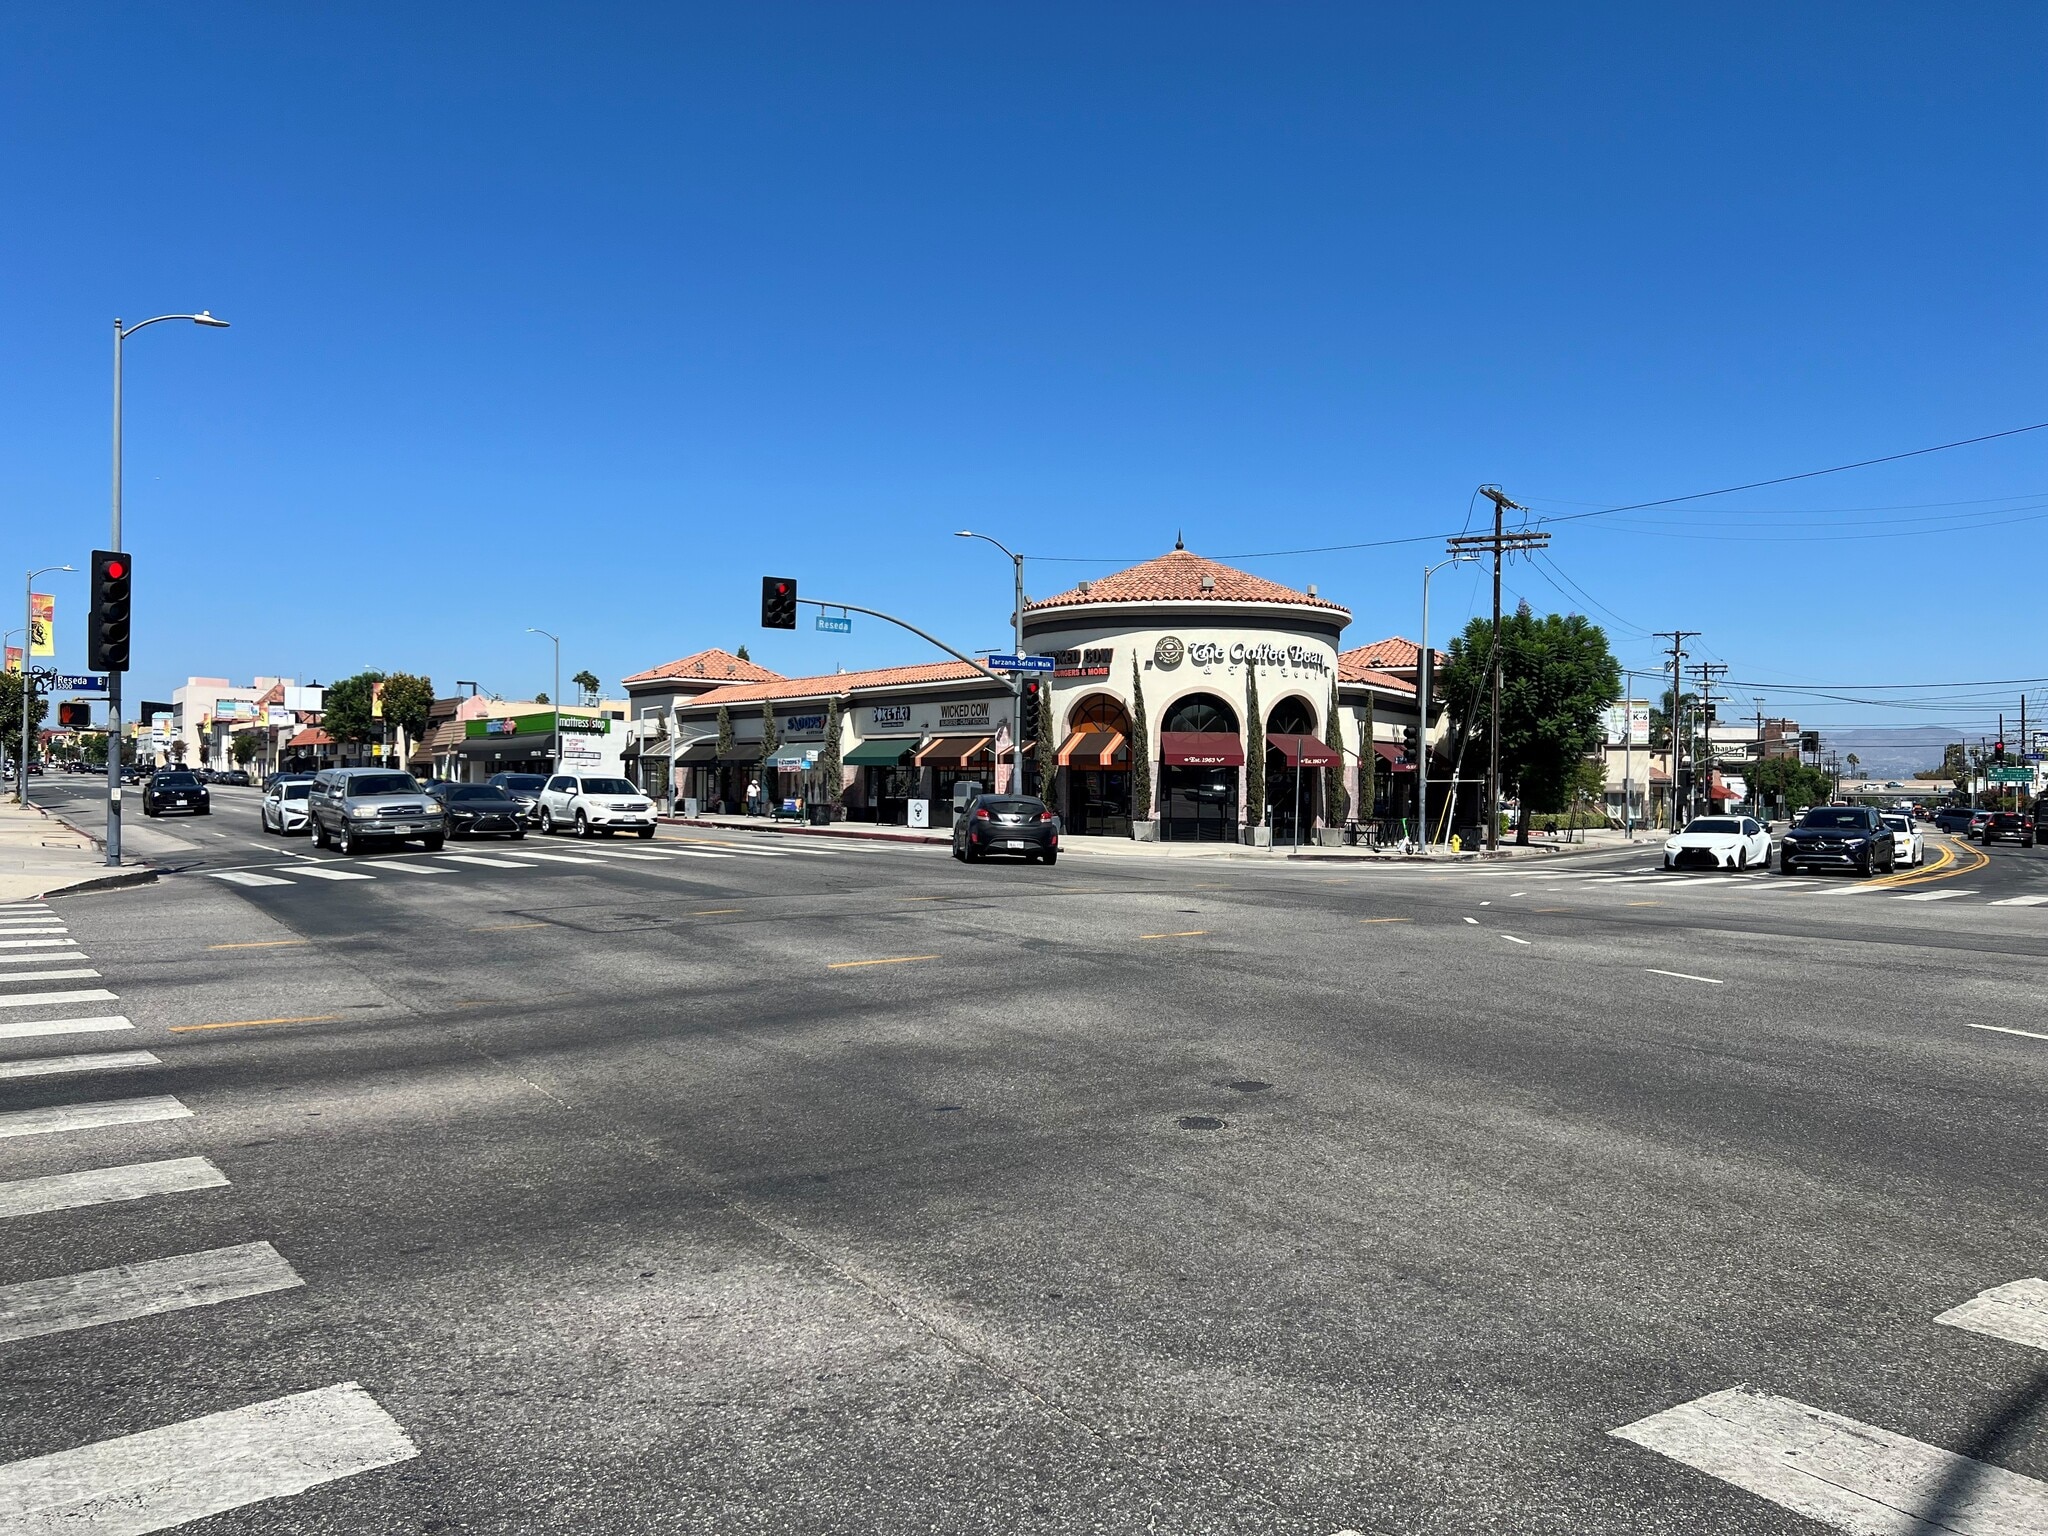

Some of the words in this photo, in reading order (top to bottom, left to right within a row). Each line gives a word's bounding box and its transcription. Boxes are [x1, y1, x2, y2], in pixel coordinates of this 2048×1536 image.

[818, 619, 849, 631] Reseda
[1083, 648, 1114, 664] COW
[1188, 642, 1224, 662] The
[1230, 642, 1288, 662] Coffee
[1289, 644, 1324, 665] Bean
[991, 658, 1016, 666] Tarzana
[1055, 669, 1080, 677] BURGERS
[1081, 668, 1087, 676] &
[1088, 667, 1108, 676] MORE
[58, 676, 87, 684] Reseda
[940, 704, 970, 719] WICKED
[970, 702, 989, 717] COW
[1632, 713, 1648, 721] K-6
[559, 717, 589, 728] mattress
[592, 719, 605, 731] stop
